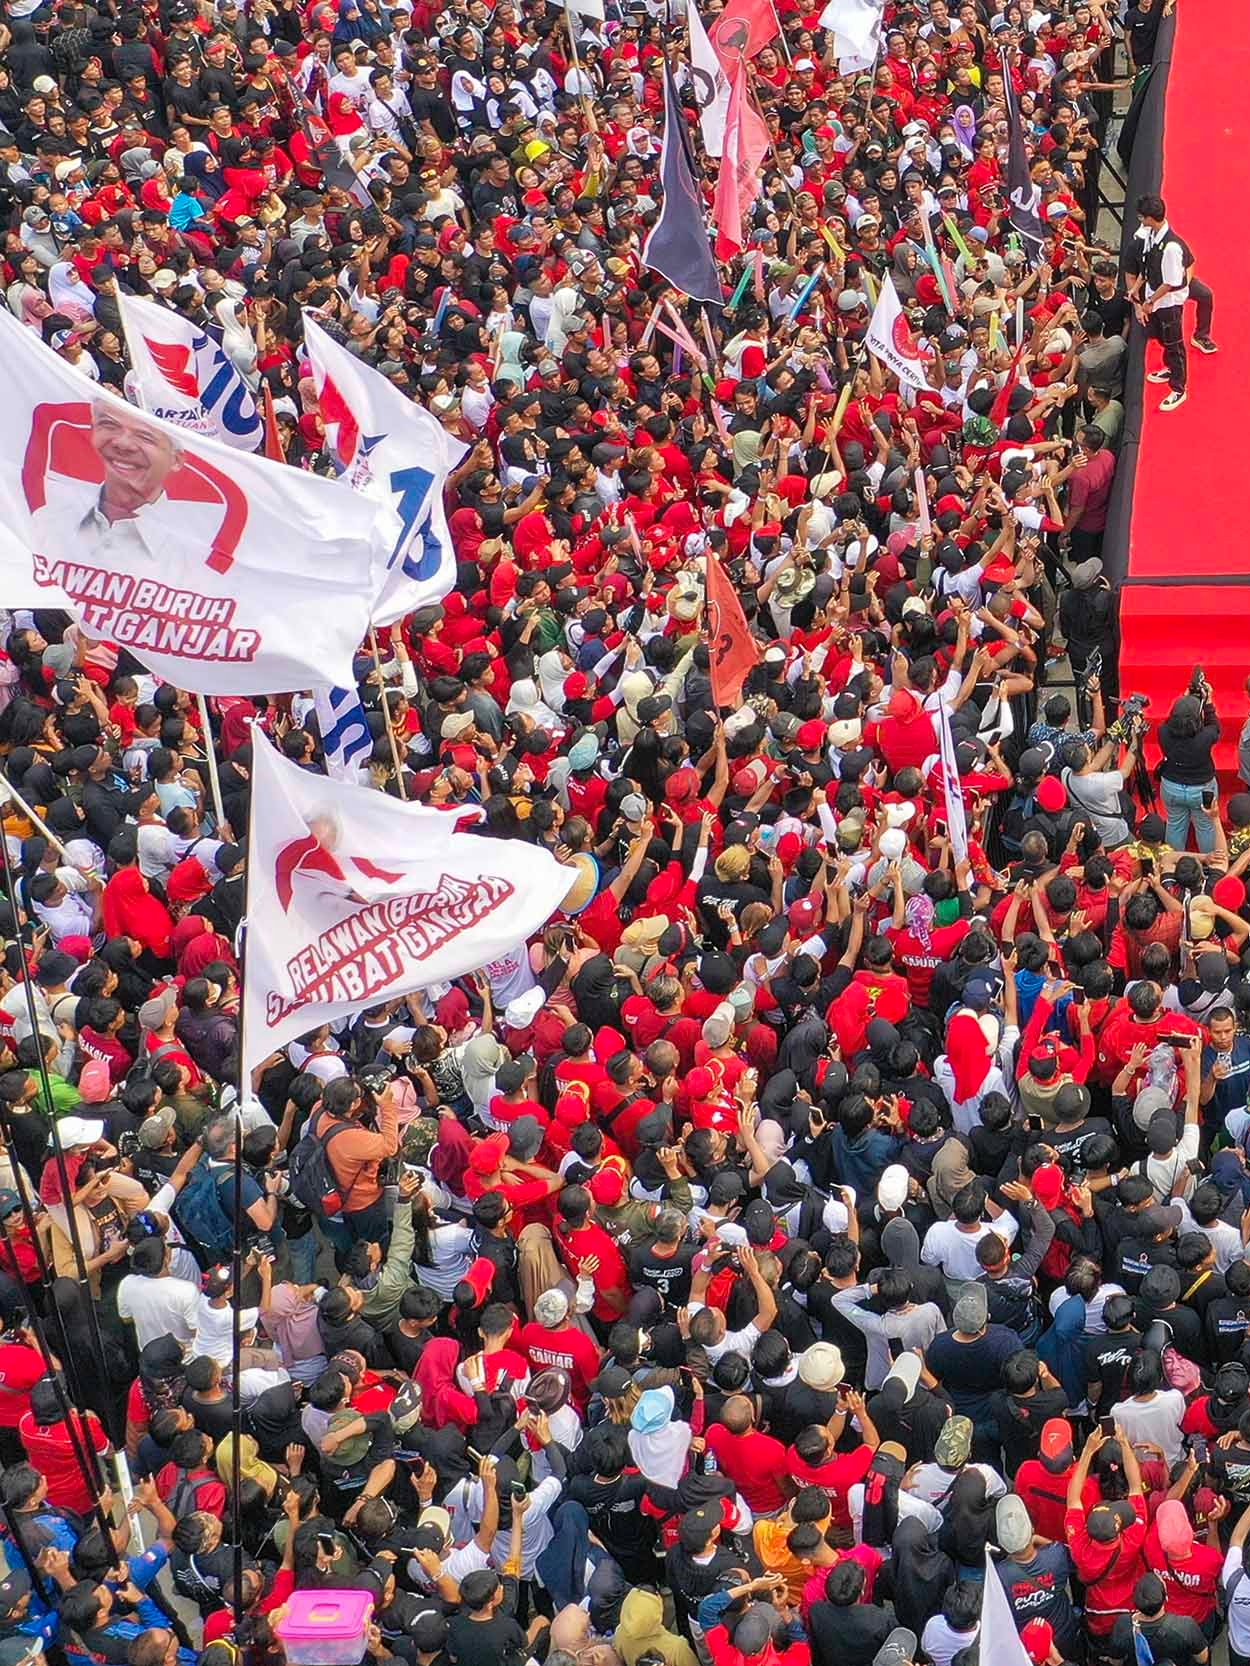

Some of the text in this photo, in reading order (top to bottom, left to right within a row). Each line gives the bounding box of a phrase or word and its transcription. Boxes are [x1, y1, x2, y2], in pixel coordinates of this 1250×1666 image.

[133, 580, 235, 624] BURUH
[114, 610, 260, 661] GANJAR
[289, 904, 387, 996] RELAWAN
